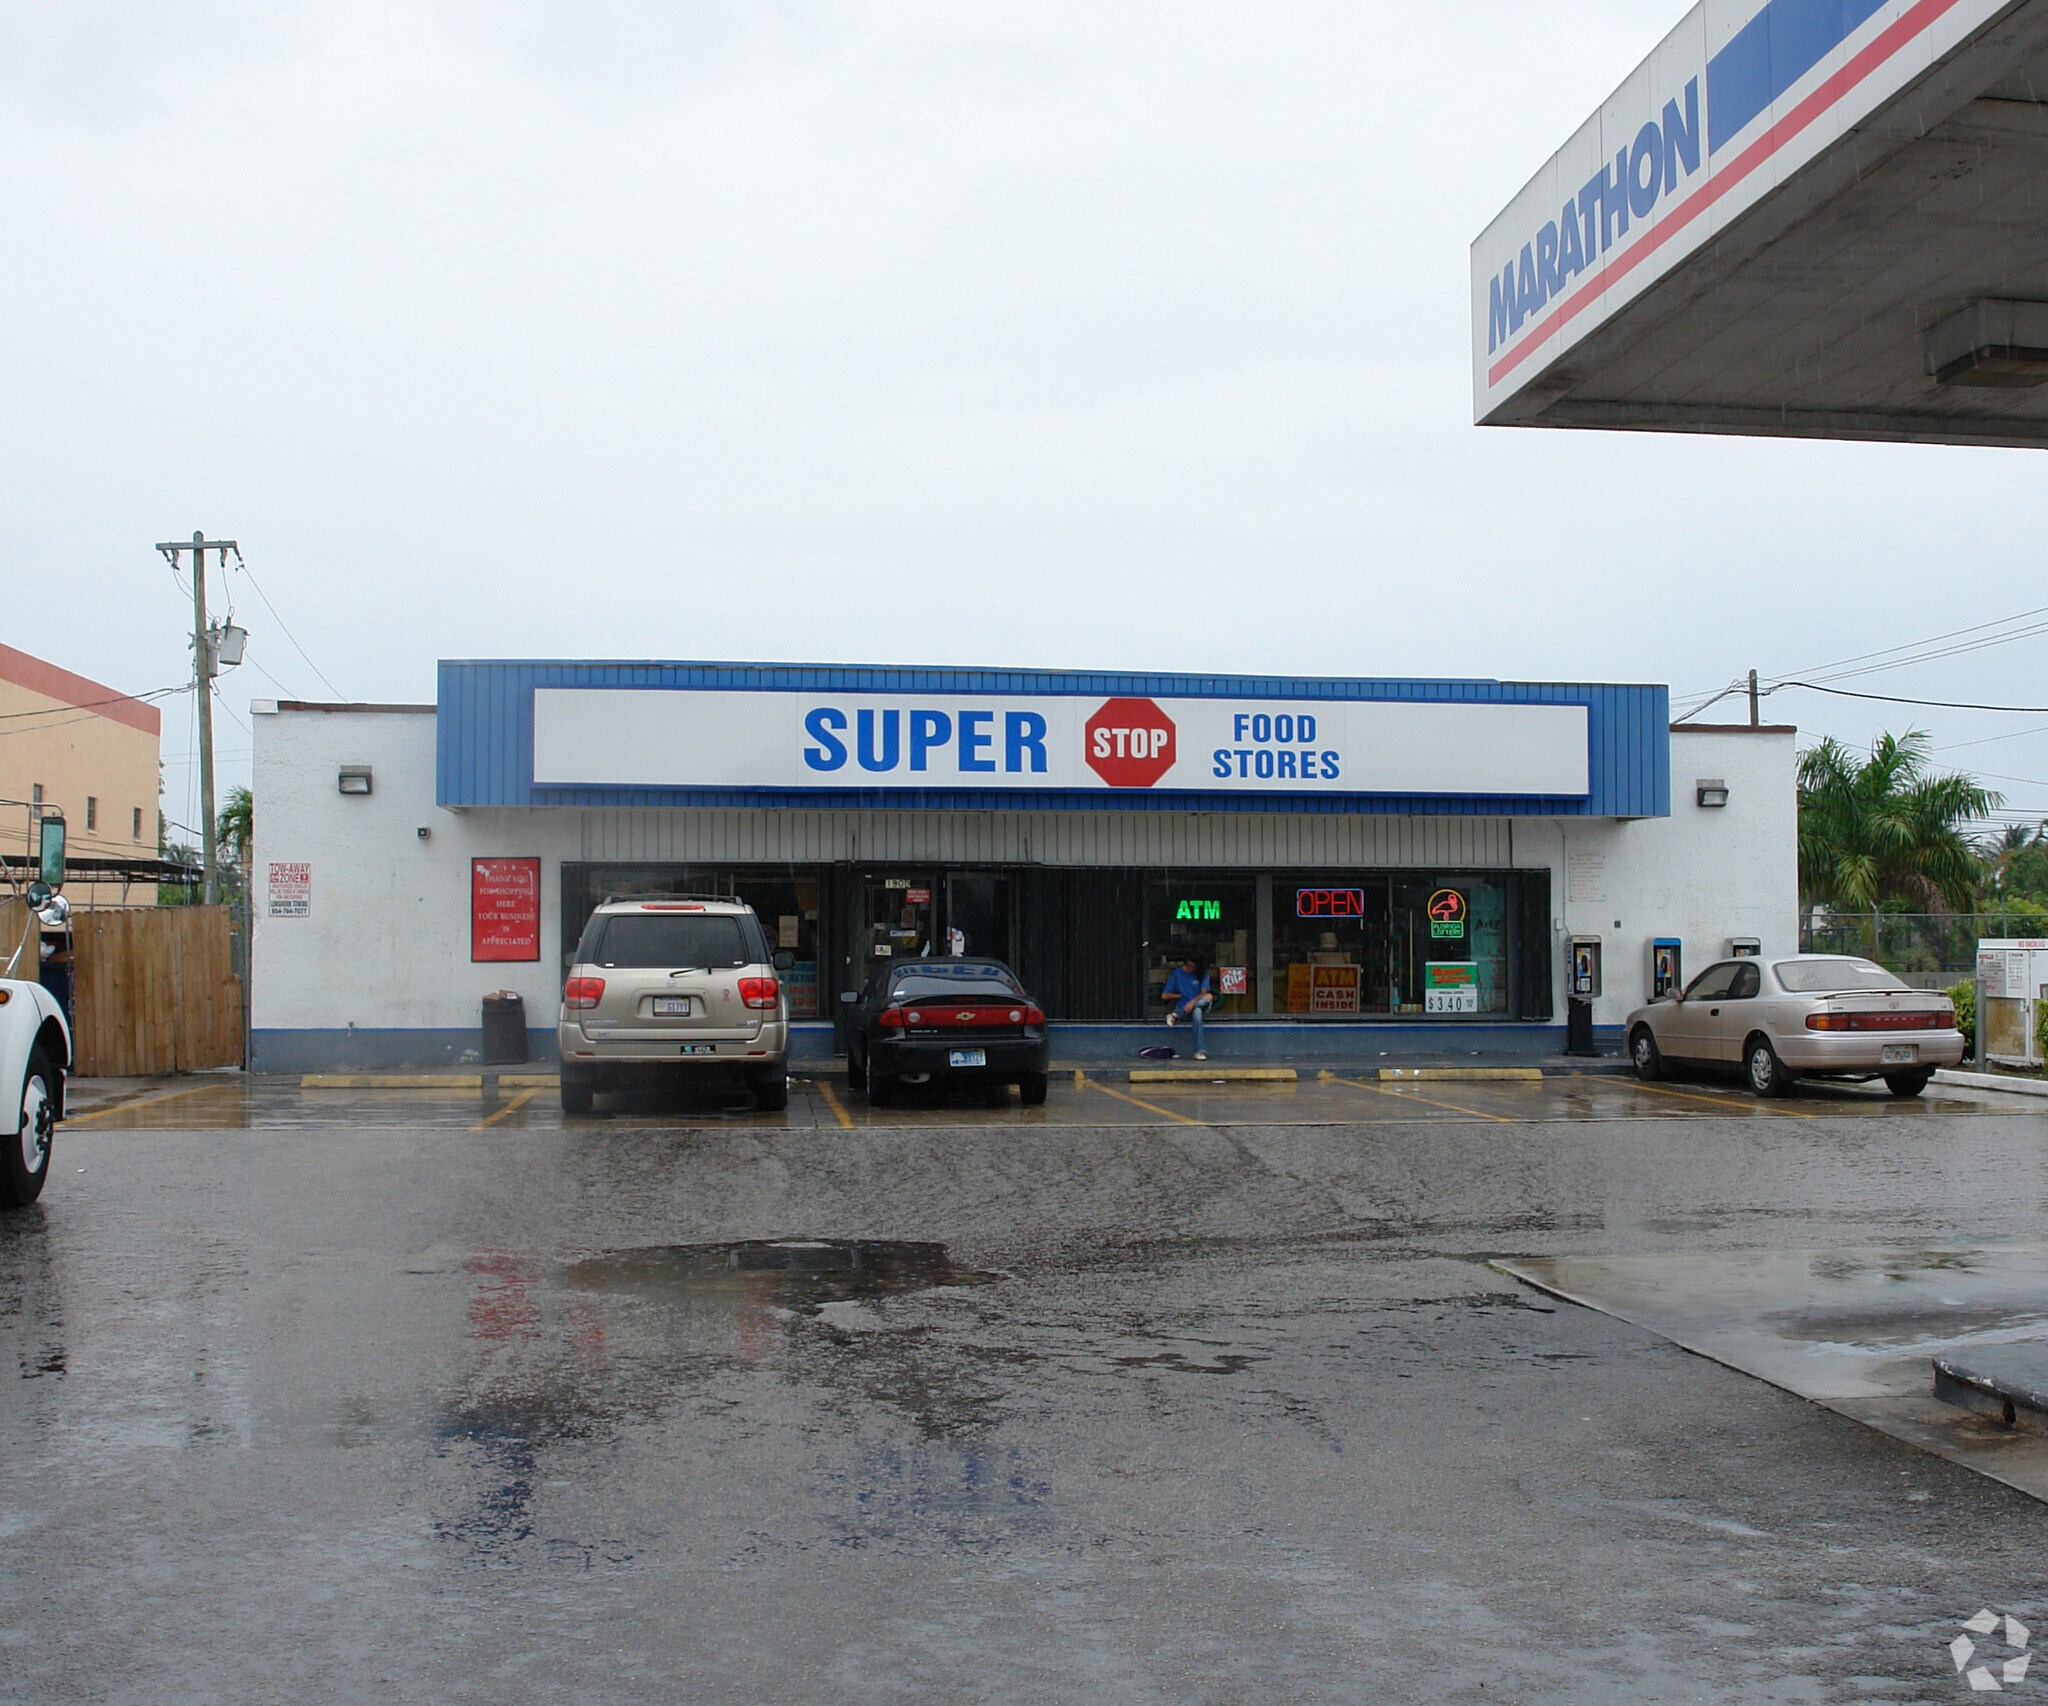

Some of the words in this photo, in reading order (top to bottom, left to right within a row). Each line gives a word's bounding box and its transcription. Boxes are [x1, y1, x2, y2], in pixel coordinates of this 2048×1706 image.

[1488, 74, 1700, 356] MARATHON
[1233, 713, 1317, 743] FOOD
[803, 707, 1048, 773] SUPER
[1093, 728, 1168, 759] STOP
[1212, 749, 1341, 779] STORES
[270, 863, 310, 873] TOW-AWAY
[280, 873, 299, 883] ZONE
[513, 875, 528, 883] YOU
[1299, 890, 1363, 915] OPEN
[478, 912, 498, 920] YOUR
[500, 912, 535, 920] BUSINESS
[1176, 900, 1221, 919] ATM
[481, 937, 531, 945] APPRECIATED
[1317, 969, 1355, 985] ATM
[1316, 990, 1355, 999] CASH
[1315, 1001, 1354, 1009] INSIDE
